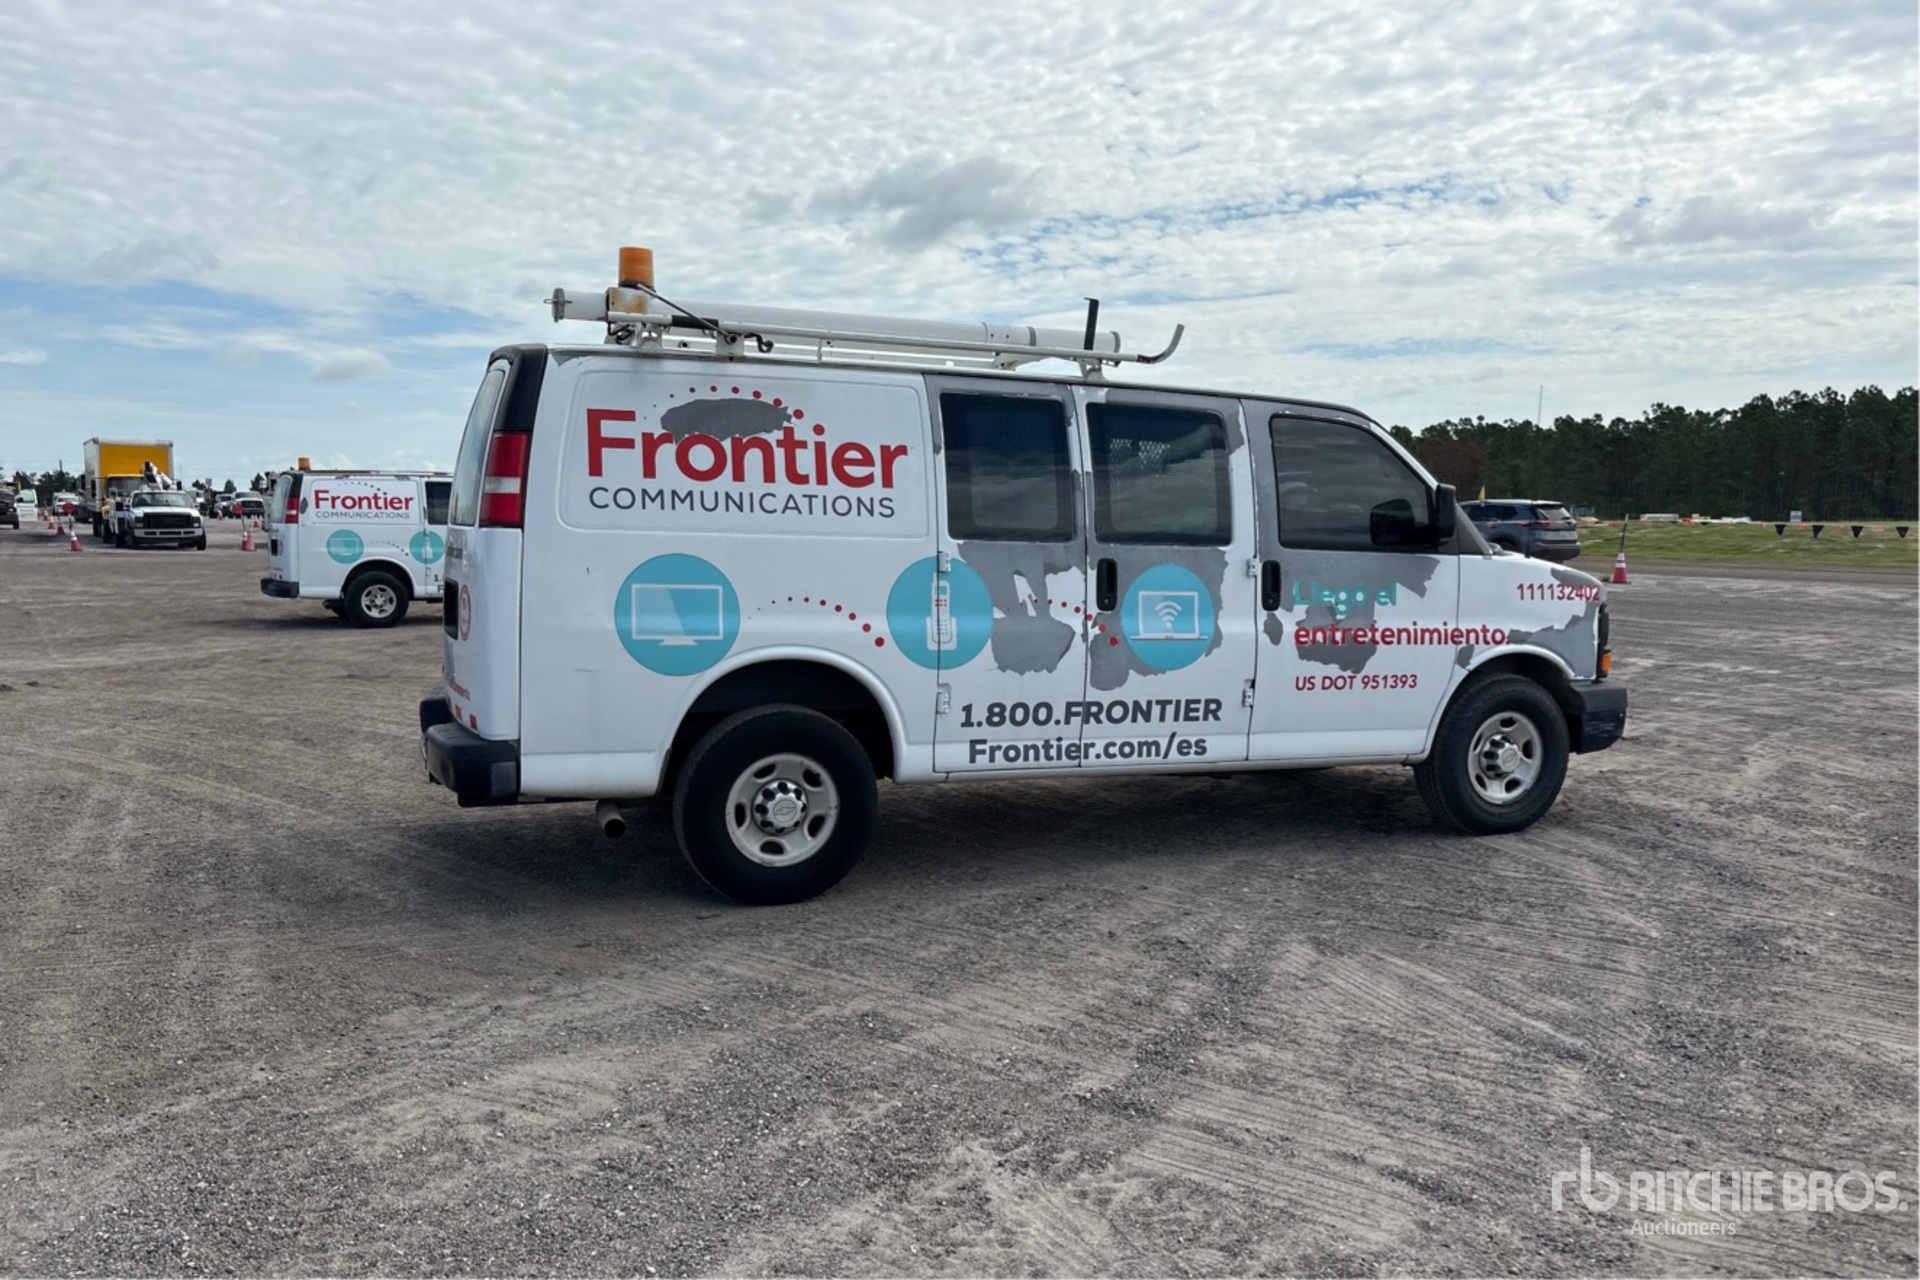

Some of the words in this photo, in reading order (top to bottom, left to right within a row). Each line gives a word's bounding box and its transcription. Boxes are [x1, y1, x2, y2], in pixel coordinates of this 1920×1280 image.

[587, 408, 908, 489] Frontier
[314, 490, 413, 510] Frontier
[589, 486, 896, 518] COMMUNICATIONS
[316, 510, 410, 519] COMMUNICATIONS
[1374, 580, 1397, 606] el
[1517, 583, 1599, 601] 111132402
[1295, 676, 1316, 691] US
[1321, 675, 1356, 690] DOT
[1361, 674, 1418, 690] 951393
[960, 698, 1222, 728] 1.800.FRONTIER
[969, 732, 1208, 764] Frontier.com/es
